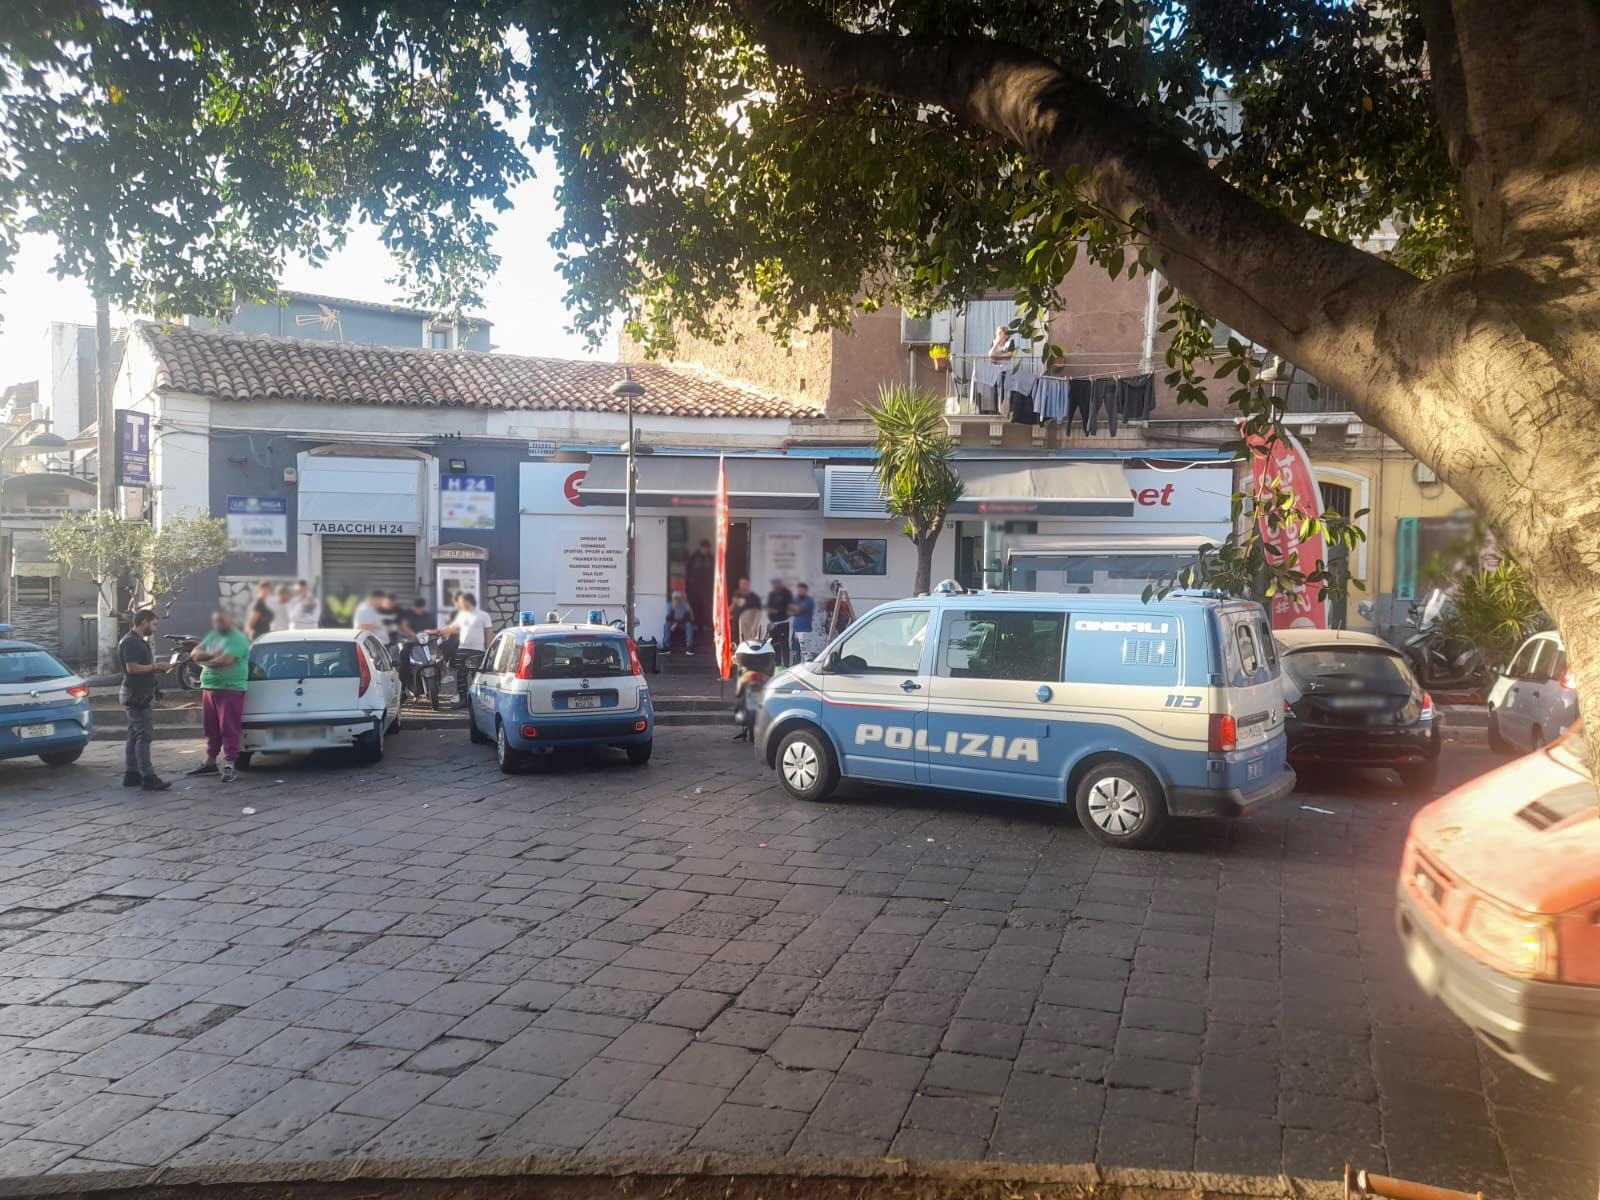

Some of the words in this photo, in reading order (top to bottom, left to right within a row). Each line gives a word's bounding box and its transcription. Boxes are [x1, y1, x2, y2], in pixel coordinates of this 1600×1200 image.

[127, 414, 145, 452] T
[448, 479, 460, 491] H
[465, 479, 487, 491] 24
[312, 523, 376, 534] TABACCHI
[379, 524, 388, 534] H
[390, 524, 404, 534] 24
[1164, 694, 1203, 709] 113
[855, 723, 1040, 763] POLIZIA
